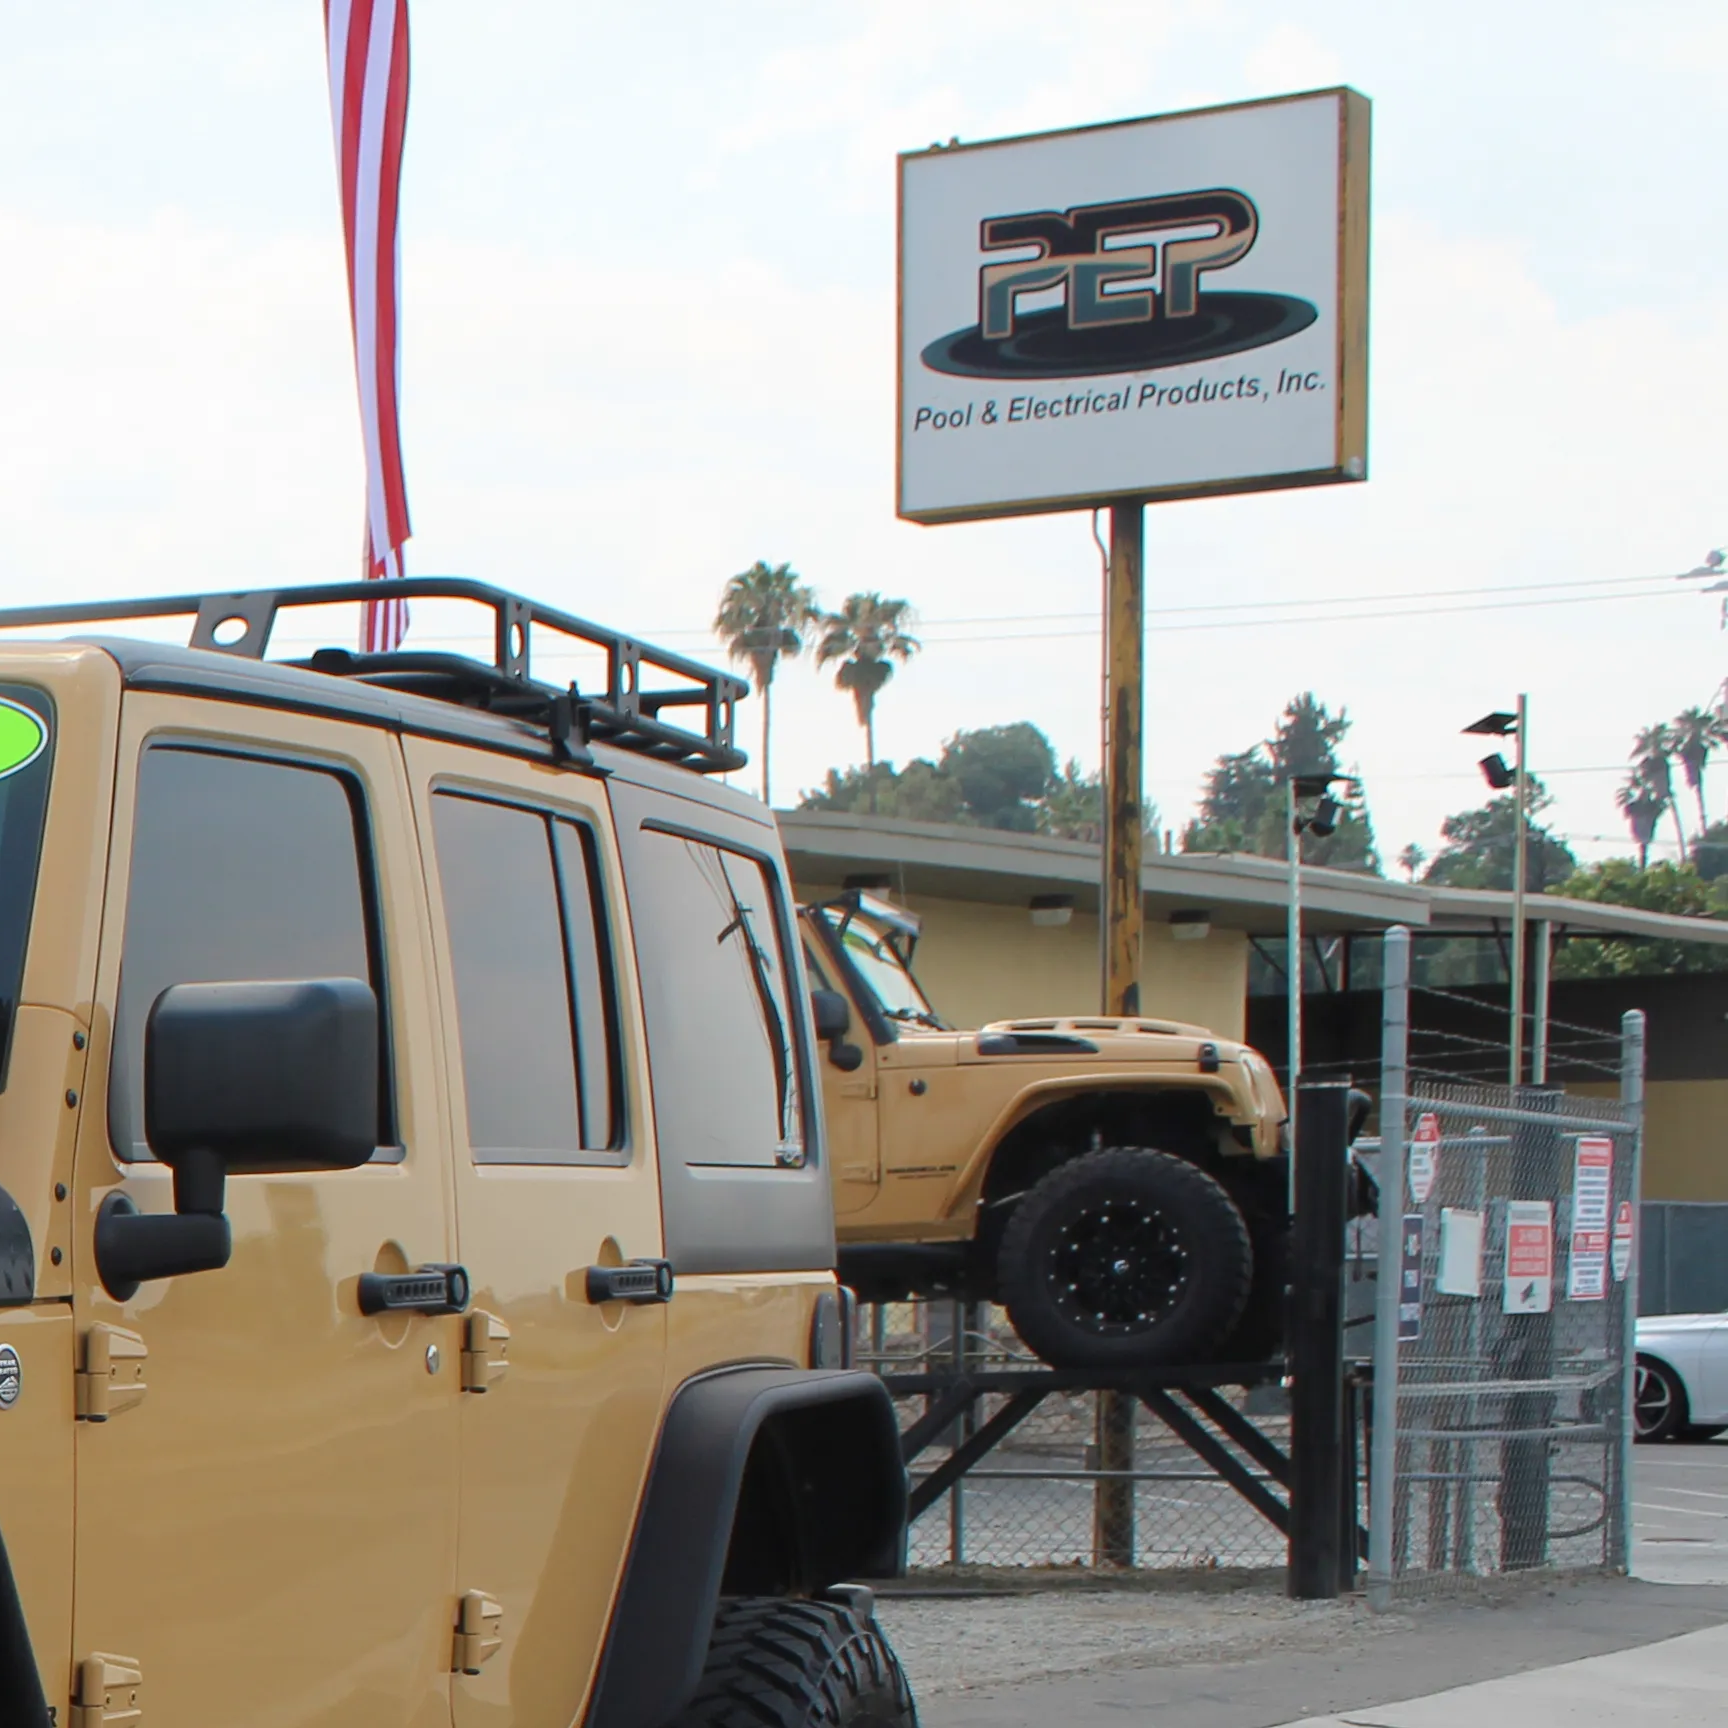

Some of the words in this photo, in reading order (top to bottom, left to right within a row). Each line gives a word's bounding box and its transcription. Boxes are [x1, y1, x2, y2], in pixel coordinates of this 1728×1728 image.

[979, 186, 1259, 341] PEP
[913, 402, 972, 432] Pool
[981, 400, 999, 426] &
[1007, 386, 1130, 423] Electrical
[1137, 373, 1270, 408] Products,
[1276, 367, 1327, 395] Inc.
